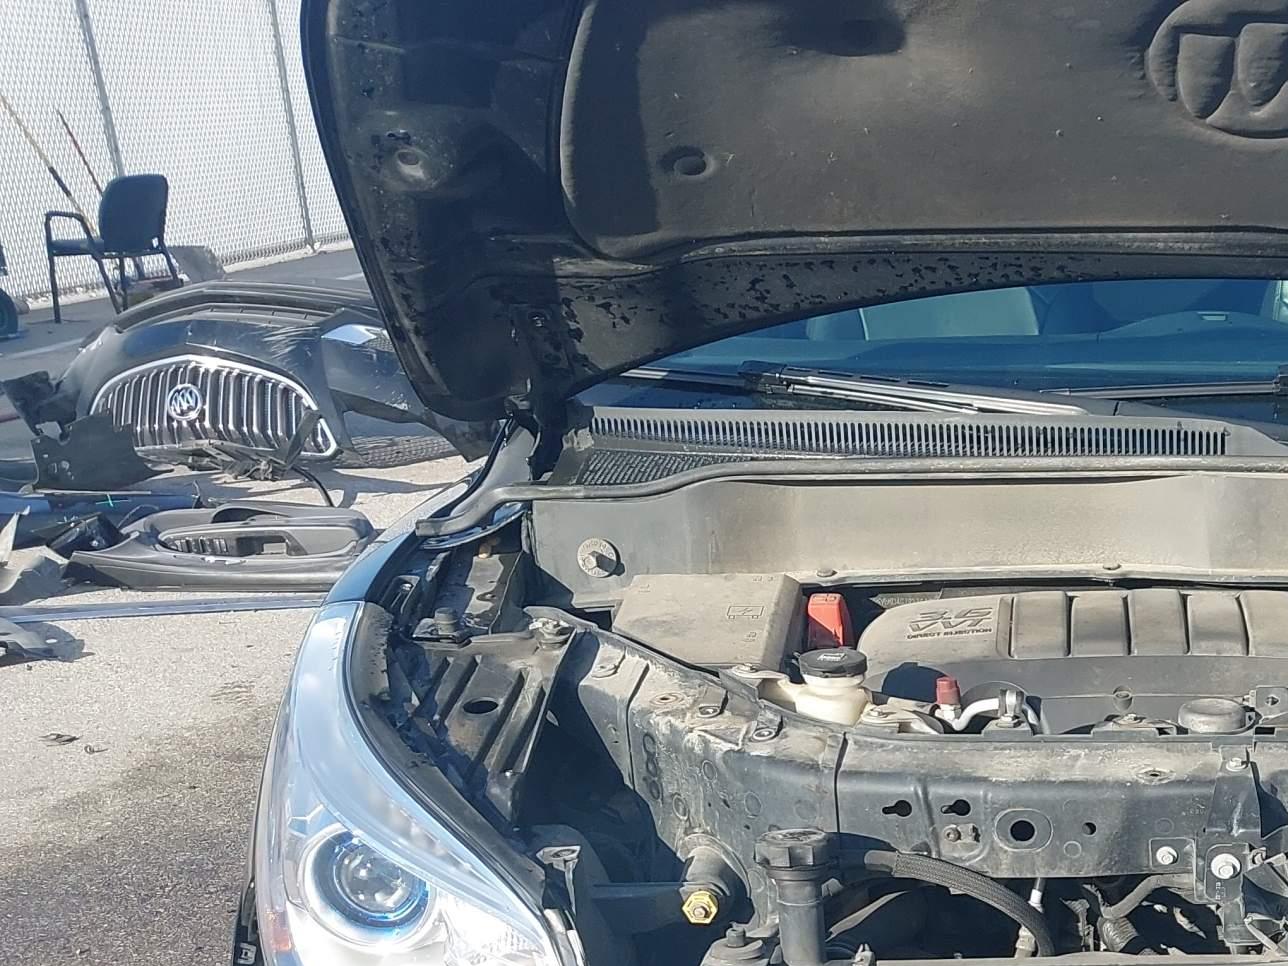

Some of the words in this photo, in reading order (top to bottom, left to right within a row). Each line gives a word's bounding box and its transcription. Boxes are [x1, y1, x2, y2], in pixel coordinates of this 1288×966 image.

[919, 607, 993, 619] 3.6
[909, 617, 993, 632] VVT
[907, 632, 941, 640] DIRECT
[943, 628, 993, 636] INJECTION
